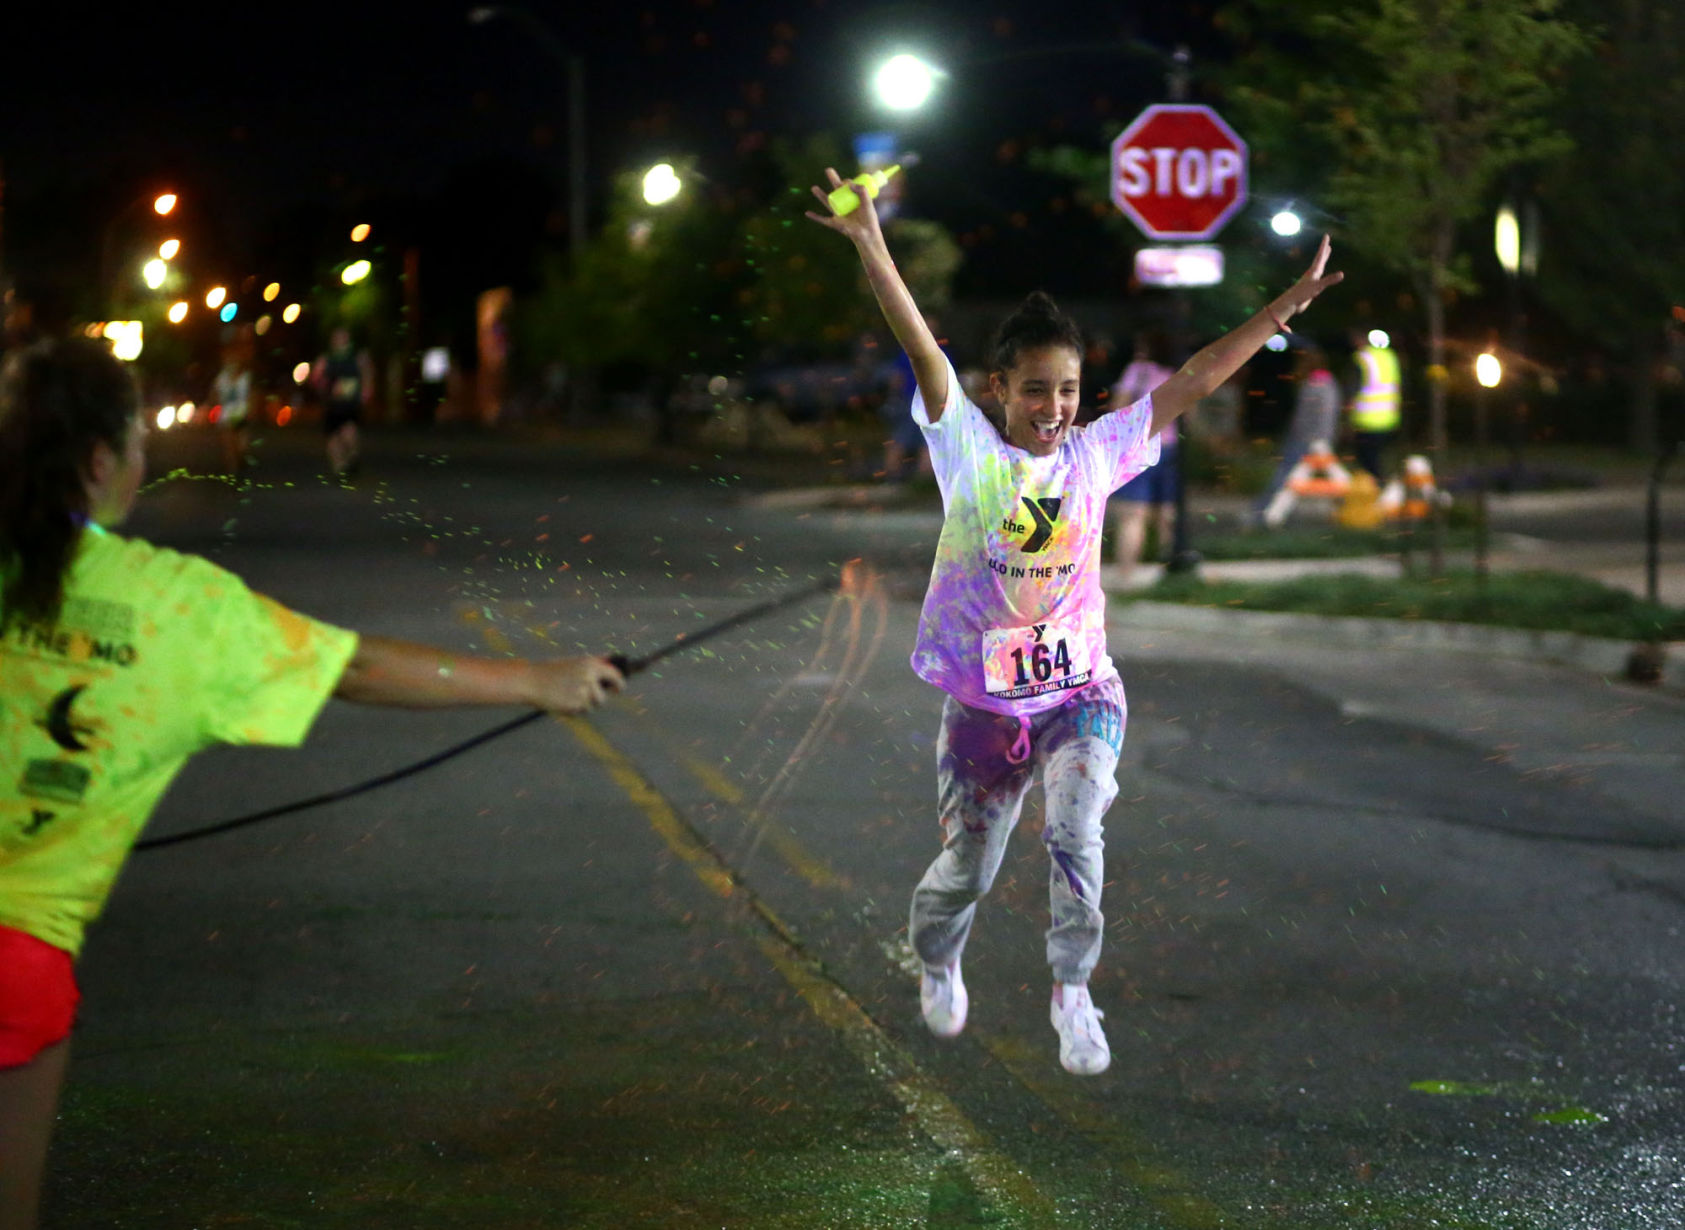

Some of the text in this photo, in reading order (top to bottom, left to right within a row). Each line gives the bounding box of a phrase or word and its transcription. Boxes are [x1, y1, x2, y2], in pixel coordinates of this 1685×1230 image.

[1118, 147, 1242, 198] STOP
[1002, 519, 1025, 533] the
[1010, 567, 1025, 578] IN
[1029, 567, 1052, 578] THE
[1010, 637, 1072, 686] 164
[1034, 680, 1066, 694] FAMILY
[1067, 672, 1090, 687] YMCA
